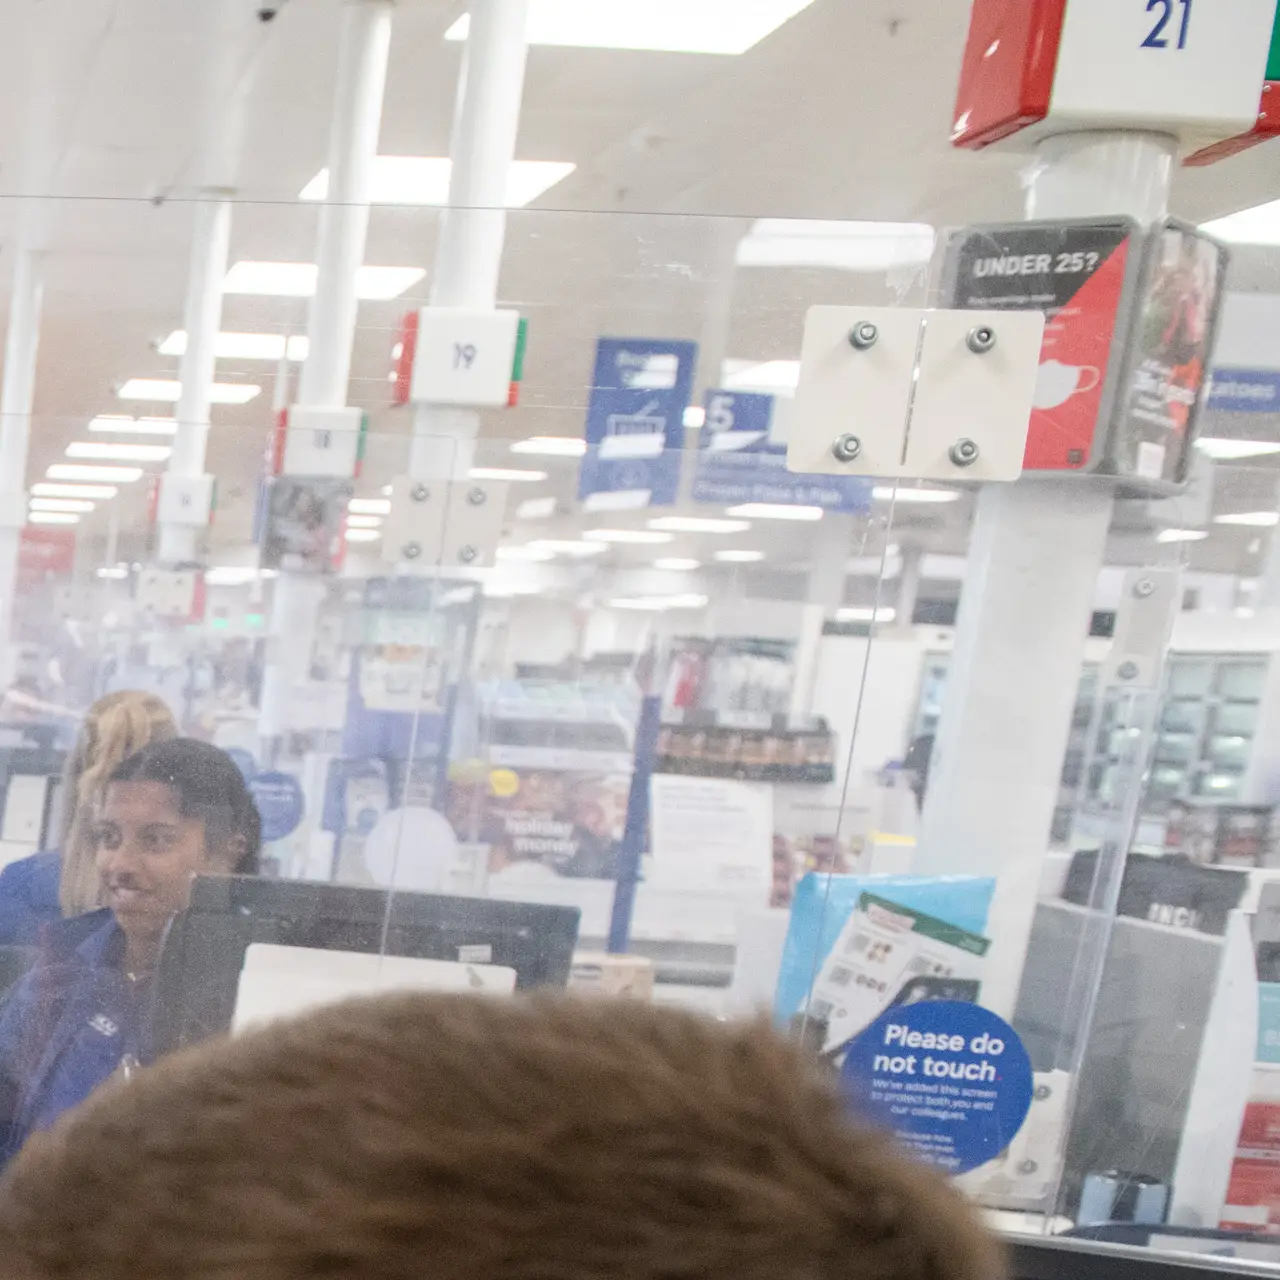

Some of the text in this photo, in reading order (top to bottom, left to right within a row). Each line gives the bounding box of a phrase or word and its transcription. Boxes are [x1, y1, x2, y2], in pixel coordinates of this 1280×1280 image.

[1140, 0, 1191, 49] 21
[973, 252, 1099, 277] UNDER 25?
[452, 341, 477, 370] 19
[704, 396, 735, 432] 5
[513, 837, 580, 858] money
[884, 1024, 1005, 1056] Please do
[873, 1054, 917, 1075] not
[872, 1078, 998, 1100] We've added this screen
[871, 1091, 995, 1112] to protect both you and
[891, 1105, 908, 1115] our
